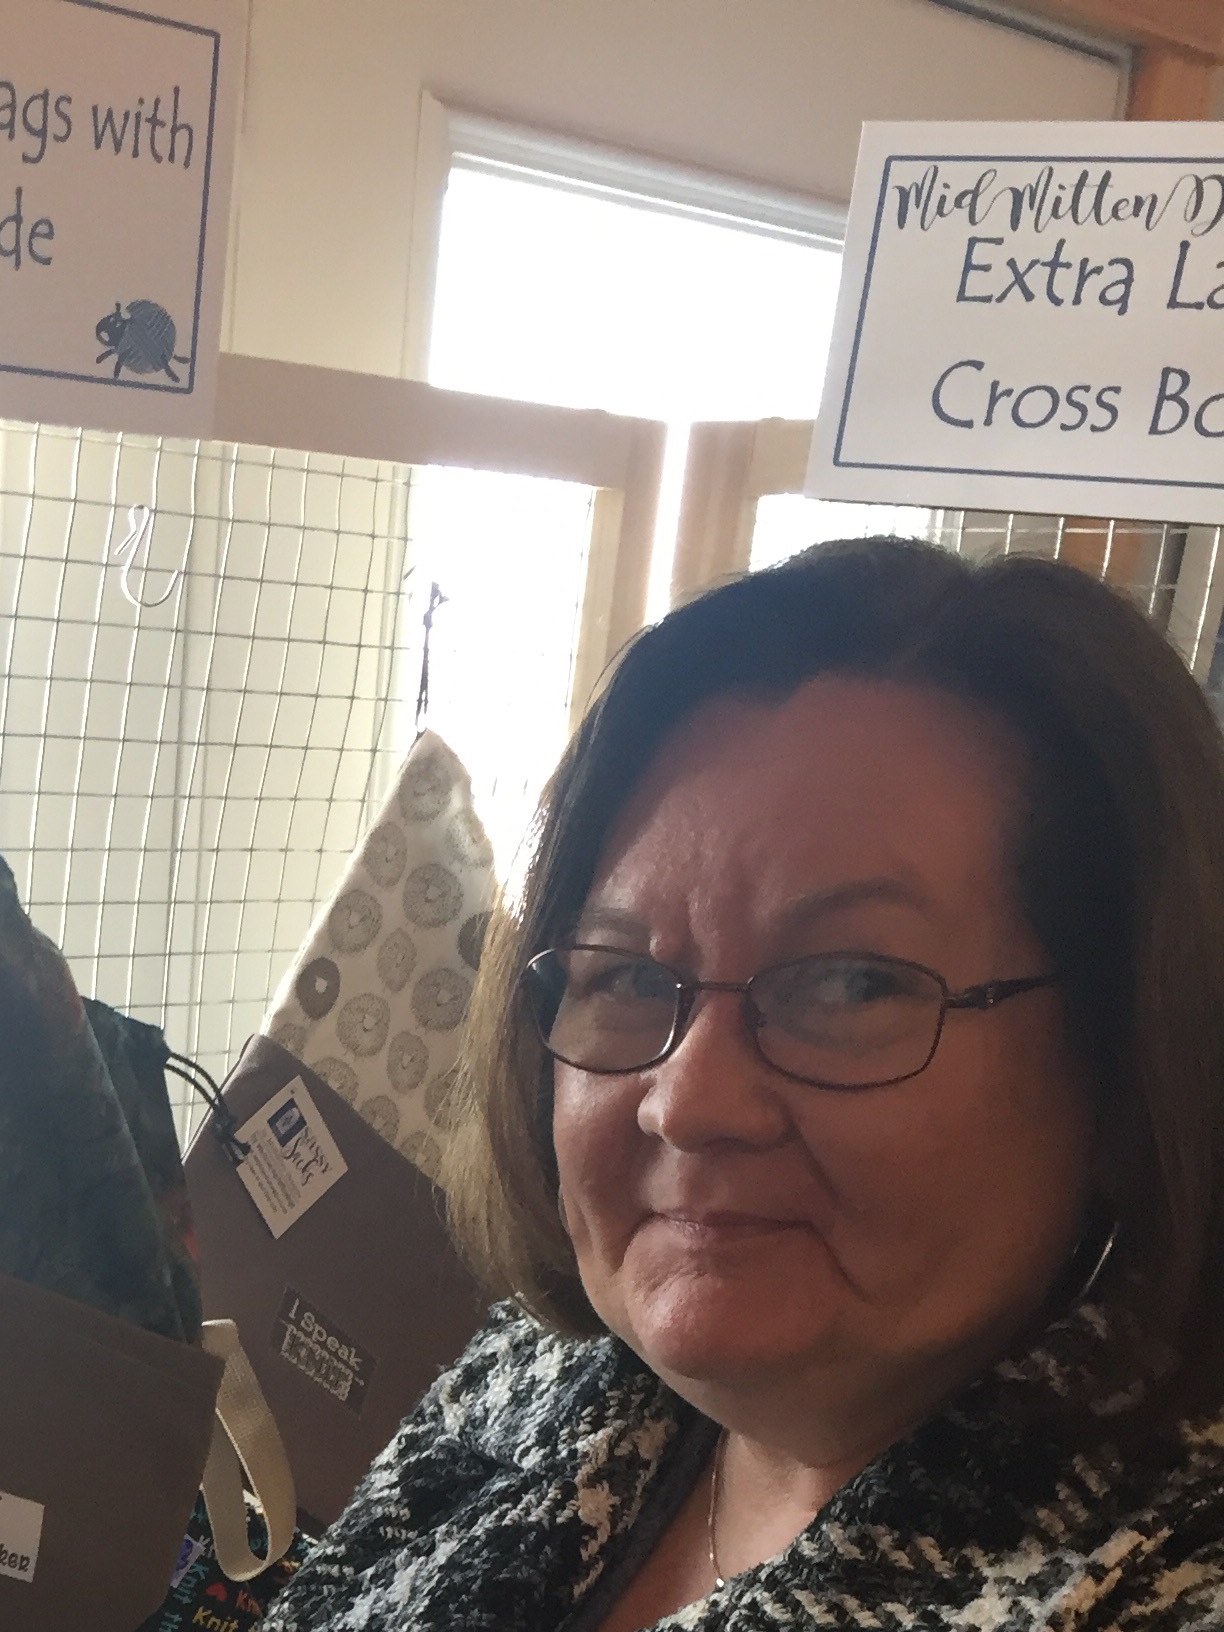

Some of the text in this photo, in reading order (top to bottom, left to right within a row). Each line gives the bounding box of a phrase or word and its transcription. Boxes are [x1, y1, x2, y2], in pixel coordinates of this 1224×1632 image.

[91, 85, 195, 169] with
[955, 236, 1136, 316] Extra
[931, 360, 1123, 434] Cross
